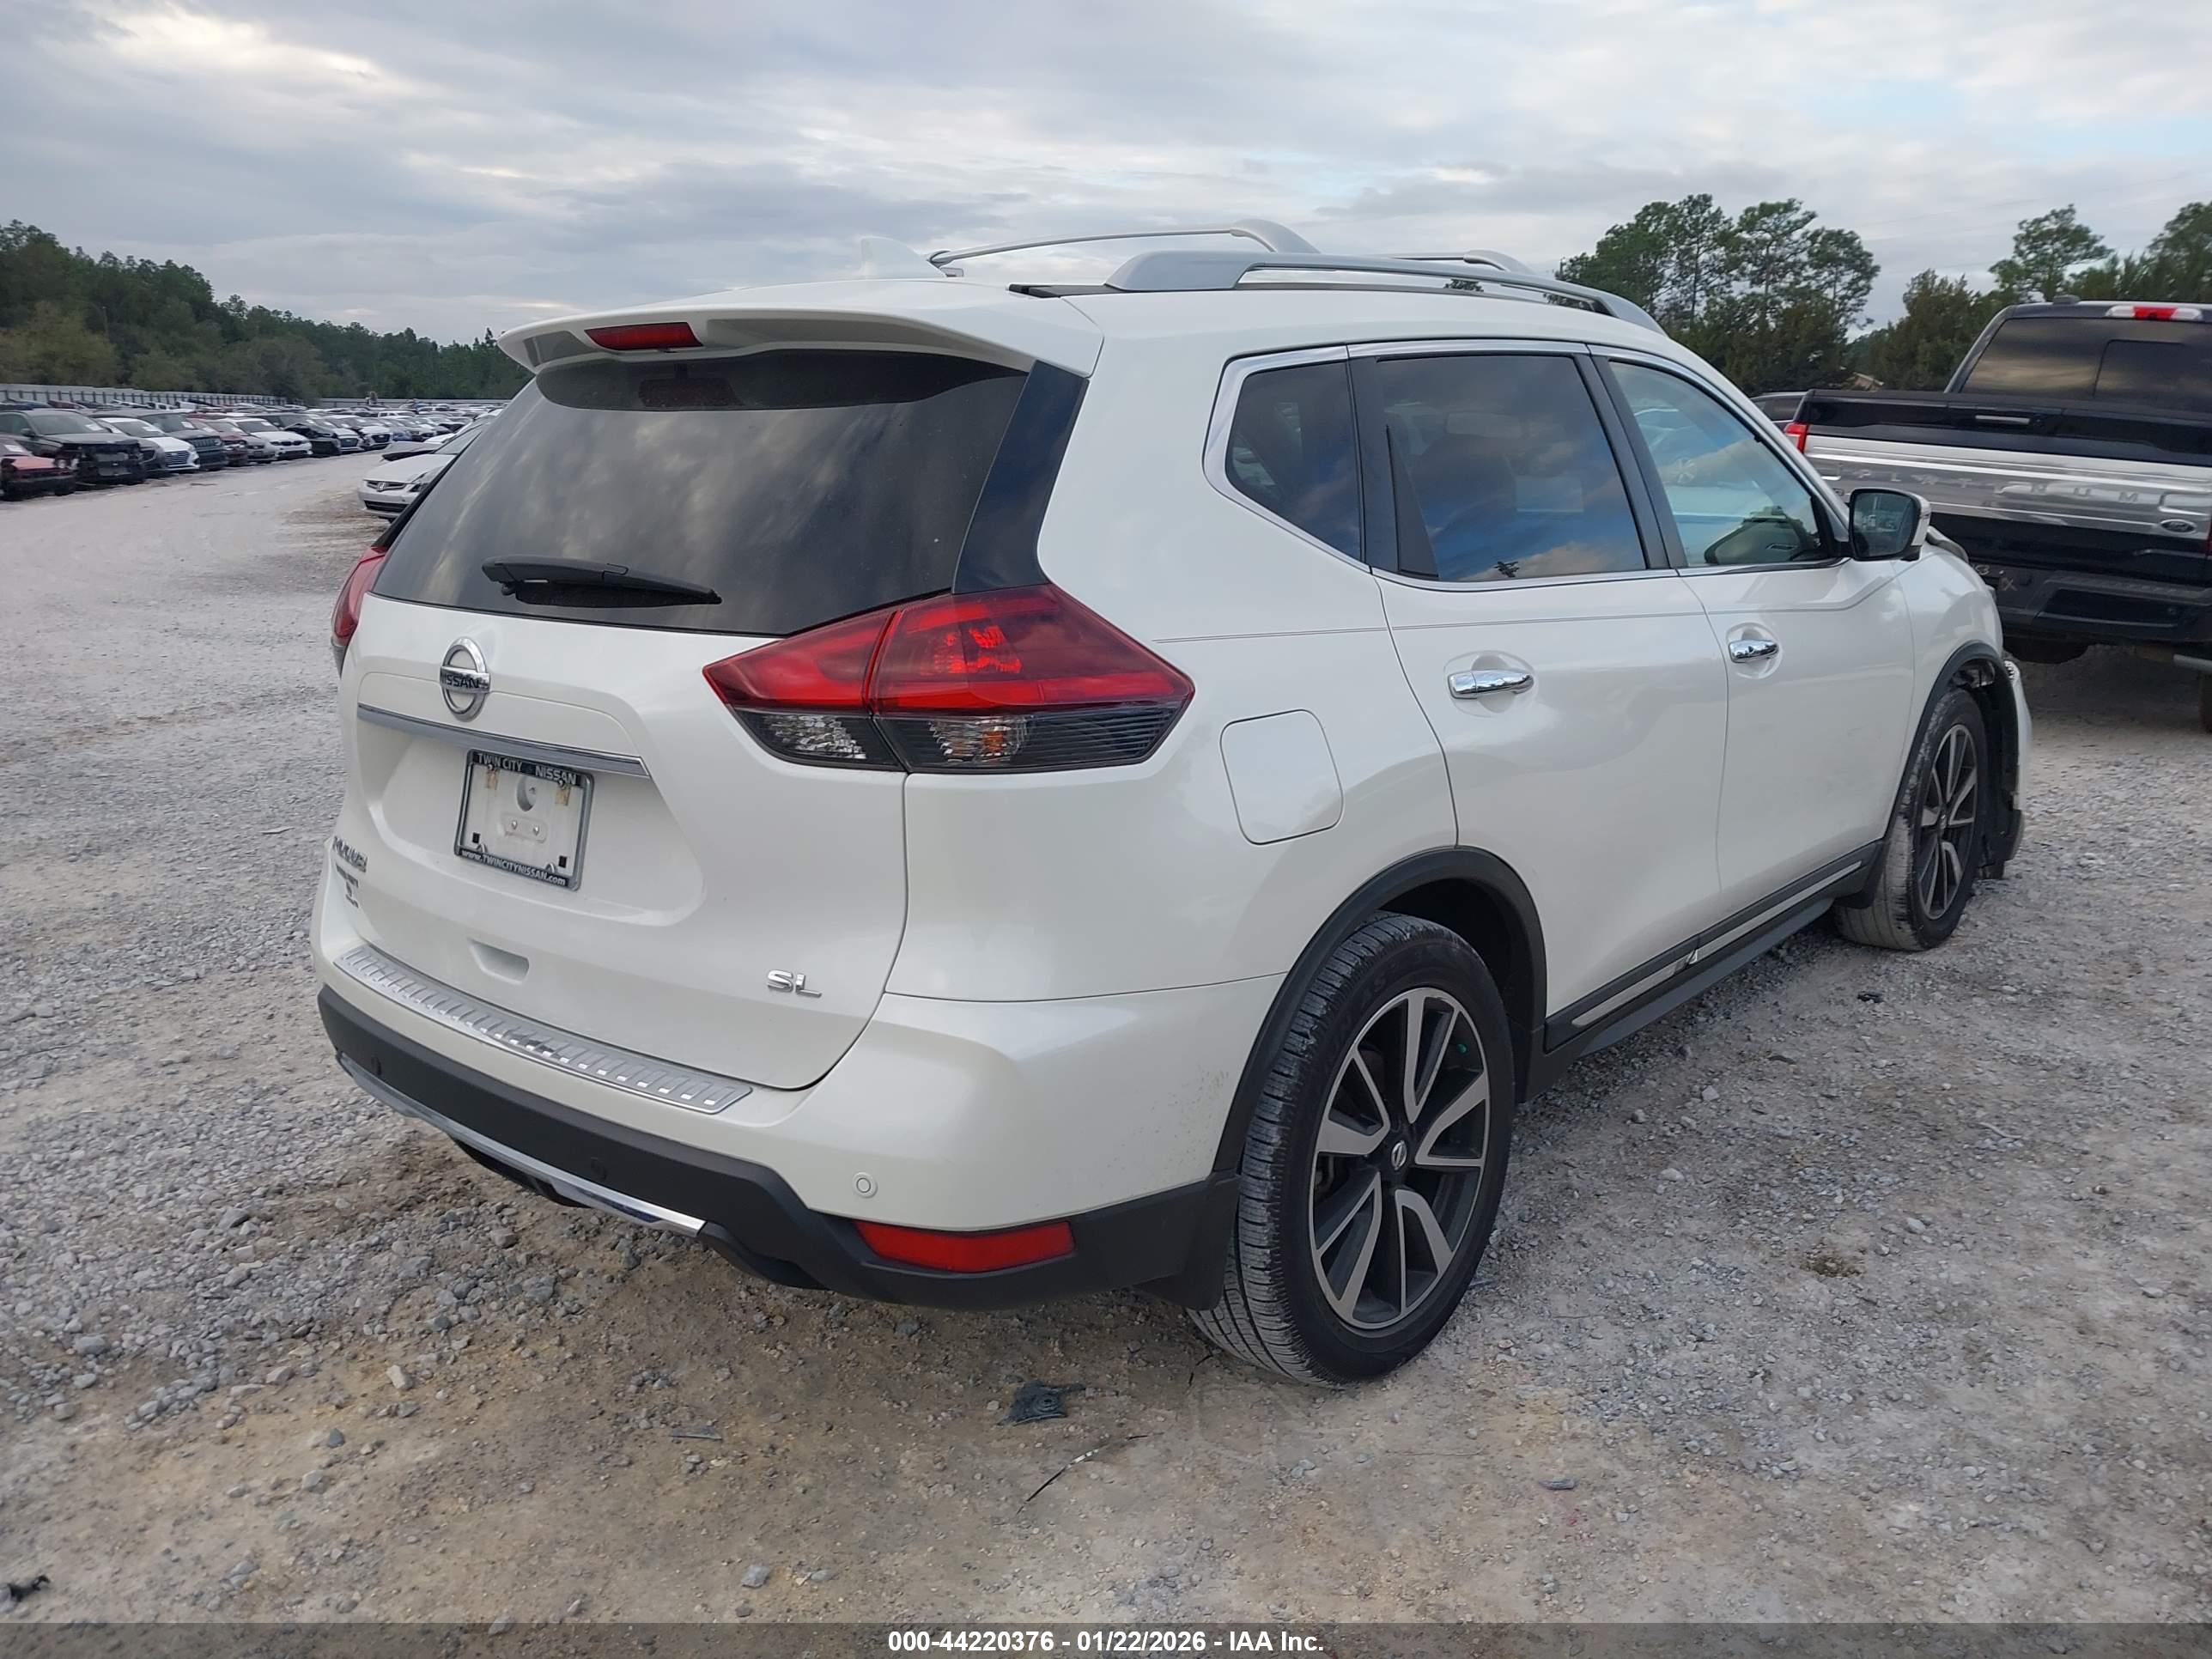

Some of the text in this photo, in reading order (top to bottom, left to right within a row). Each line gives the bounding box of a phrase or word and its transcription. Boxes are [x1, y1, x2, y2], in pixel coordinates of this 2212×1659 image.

[477, 752, 578, 785] TWIN CITY NISSAN
[460, 848, 567, 886] www.TWINCITYNISSAN.com
[766, 969, 823, 999] SL
